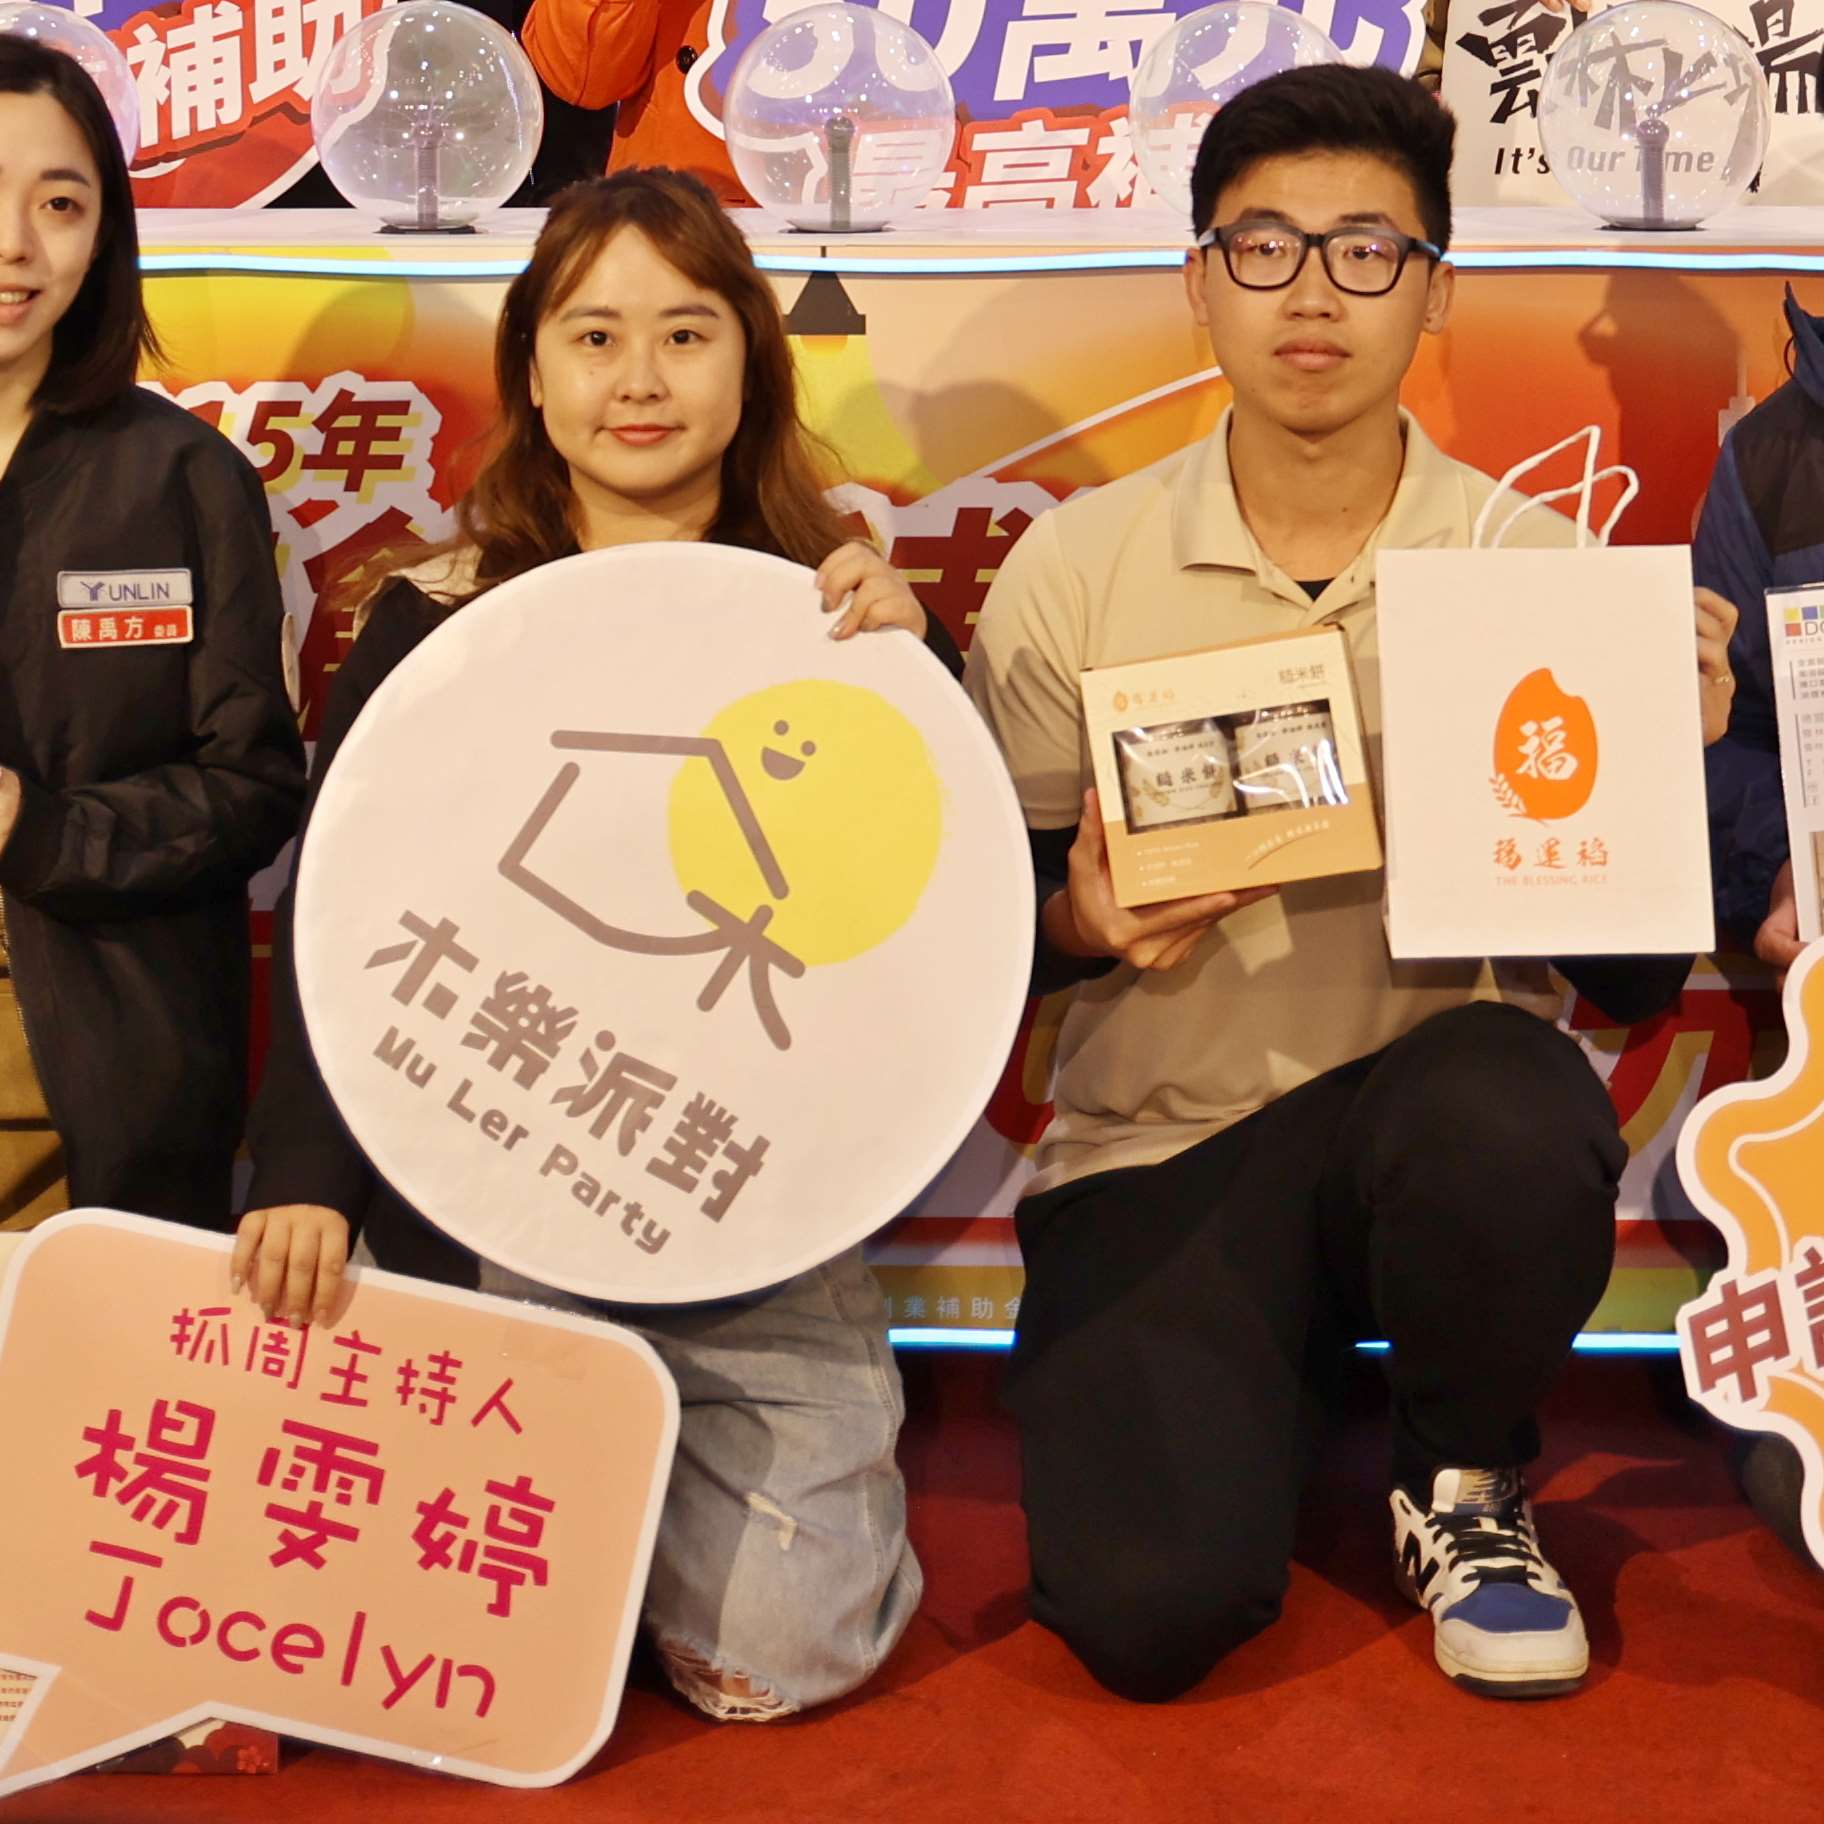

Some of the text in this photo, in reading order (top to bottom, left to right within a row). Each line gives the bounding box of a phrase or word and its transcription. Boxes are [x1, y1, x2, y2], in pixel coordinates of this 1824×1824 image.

[1494, 144, 1715, 175] It's Our Tme
[1516, 716, 1579, 780] 福
[372, 1026, 671, 1257] Mu Ler Party
[169, 1306, 526, 1436] 抓周主持人
[74, 1398, 558, 1619] 楊雯婷
[84, 1540, 497, 1719] Jocelyn
